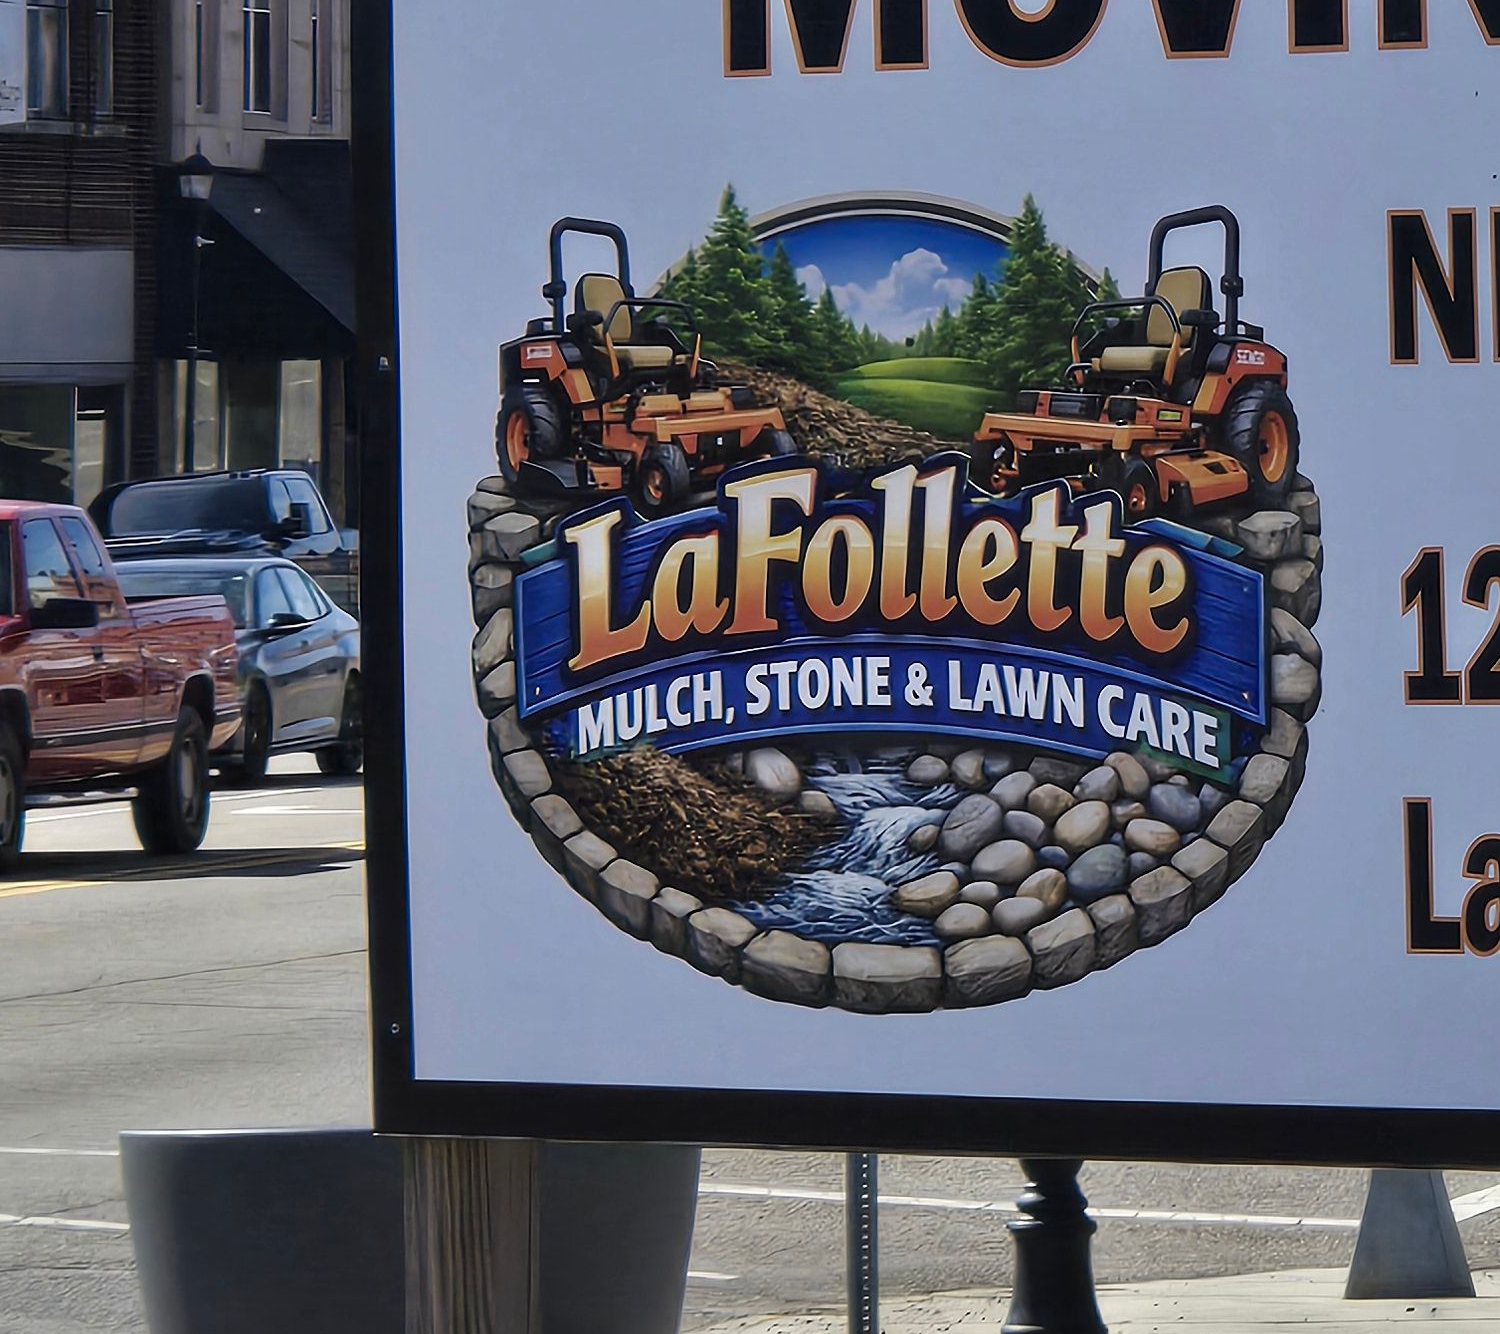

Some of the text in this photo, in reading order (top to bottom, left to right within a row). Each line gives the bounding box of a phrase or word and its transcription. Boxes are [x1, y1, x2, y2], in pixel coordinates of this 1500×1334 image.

[565, 463, 1191, 671] LaFollette
[576, 656, 1220, 767] MULCH, STONE & LAWN CARE
